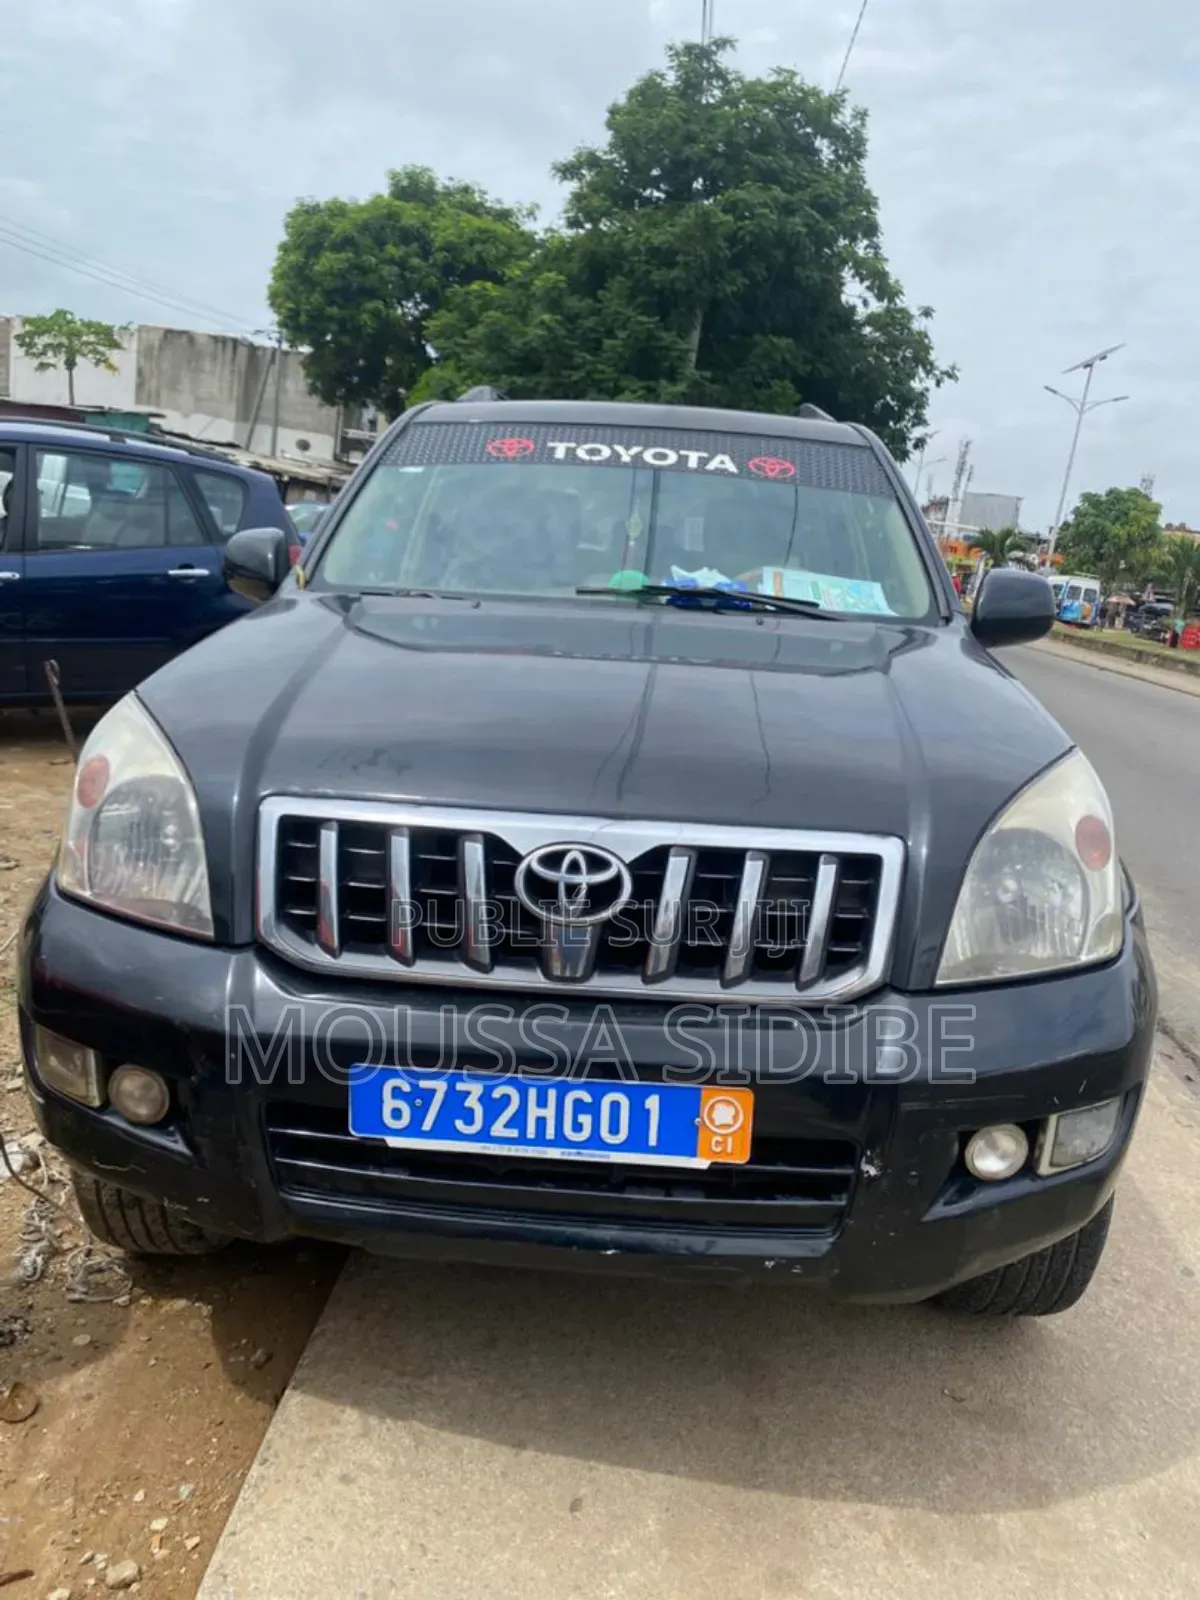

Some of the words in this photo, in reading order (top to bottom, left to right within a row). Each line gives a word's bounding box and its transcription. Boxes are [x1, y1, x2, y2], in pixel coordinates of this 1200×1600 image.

[547, 441, 738, 474] TOYOTA
[381, 1079, 661, 1147] 6732HG01
[710, 1136, 733, 1155] CI
